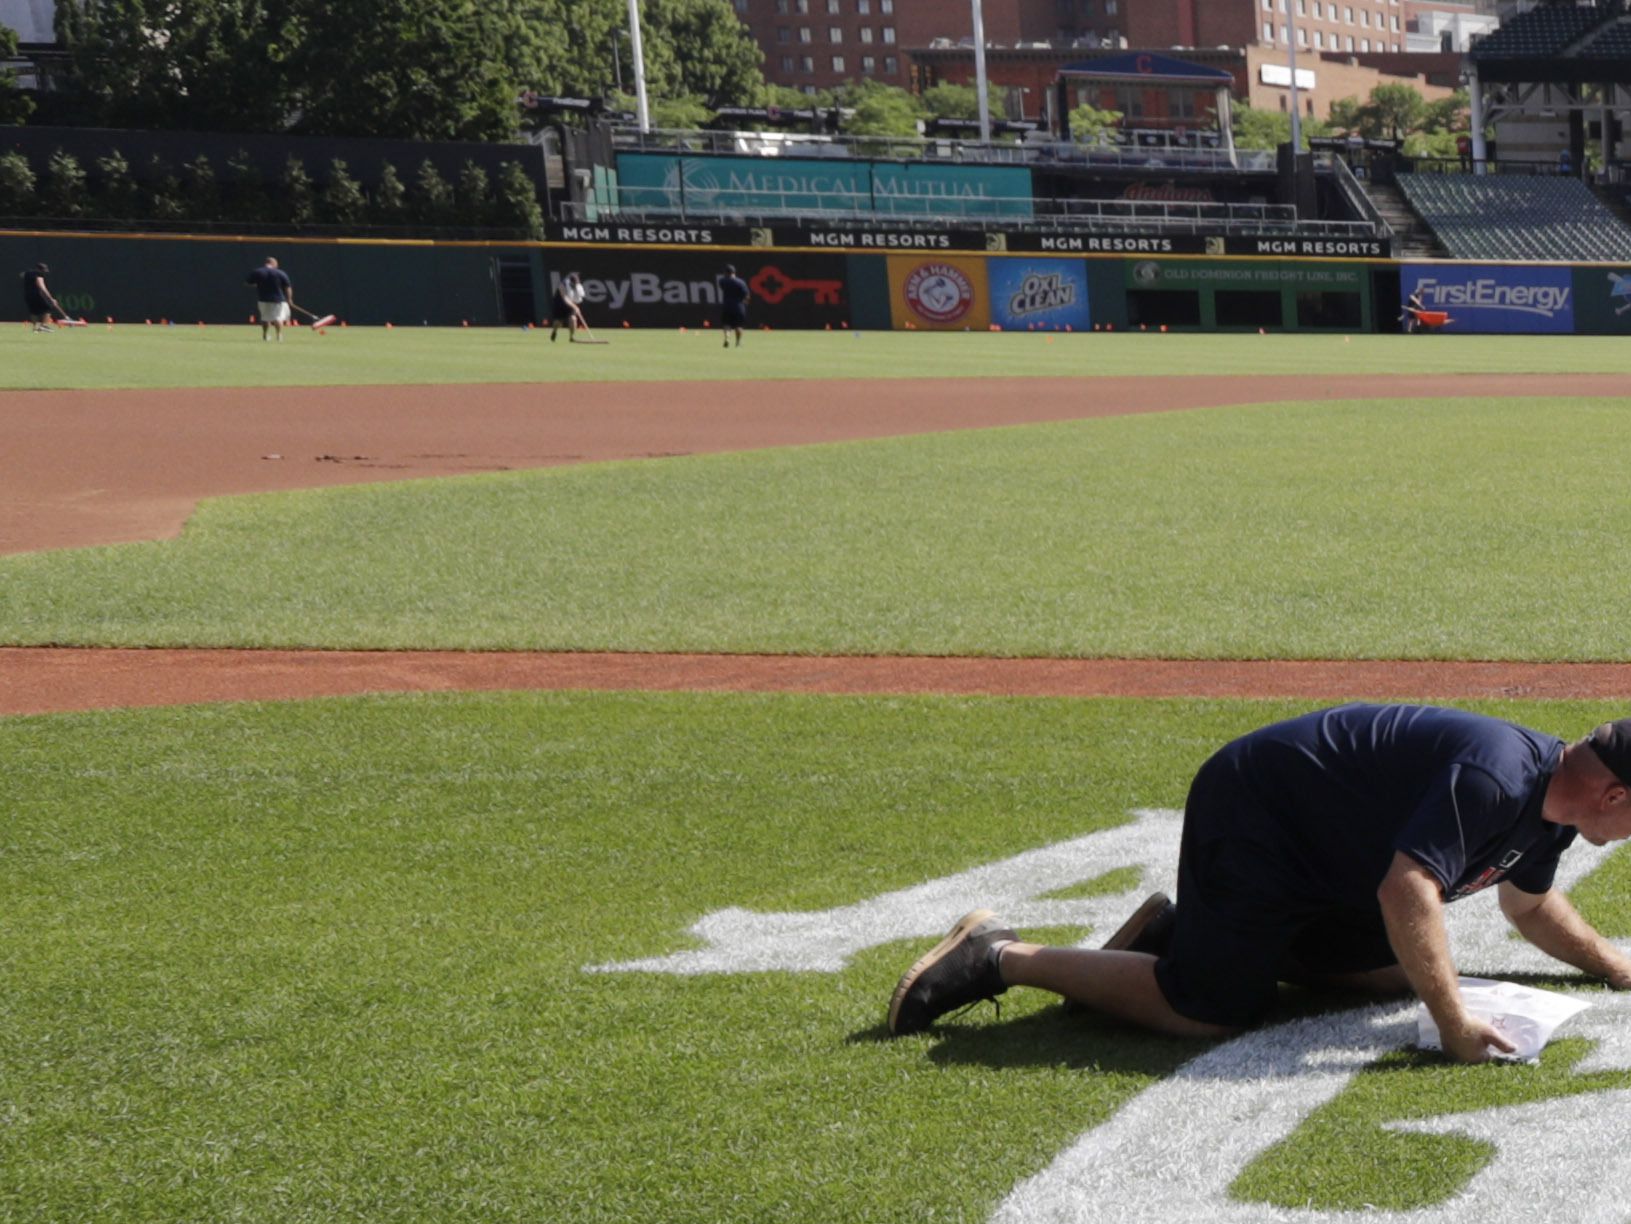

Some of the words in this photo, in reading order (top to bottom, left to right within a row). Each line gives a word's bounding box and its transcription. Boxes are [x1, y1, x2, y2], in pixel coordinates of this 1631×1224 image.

[729, 171, 859, 194] MEDICAL
[873, 175, 987, 198] MUTUAL
[563, 227, 610, 240] MGM
[618, 228, 712, 242] RESORTS
[810, 232, 854, 245] MGM
[862, 233, 950, 247] RESORTS
[1041, 237, 1084, 250] MGM
[1089, 238, 1172, 251] RESORTS
[1258, 241, 1296, 252] MGM
[1303, 242, 1381, 254] RESORTS
[930, 265, 971, 299] HAMMER
[1164, 269, 1188, 279] OLD
[1191, 269, 1251, 280] DOMINION
[1255, 270, 1303, 281] FREIGHT
[1023, 275, 1059, 292] OXI
[1011, 286, 1073, 315] CLEAN
[1417, 278, 1570, 309] FirstEnergy
